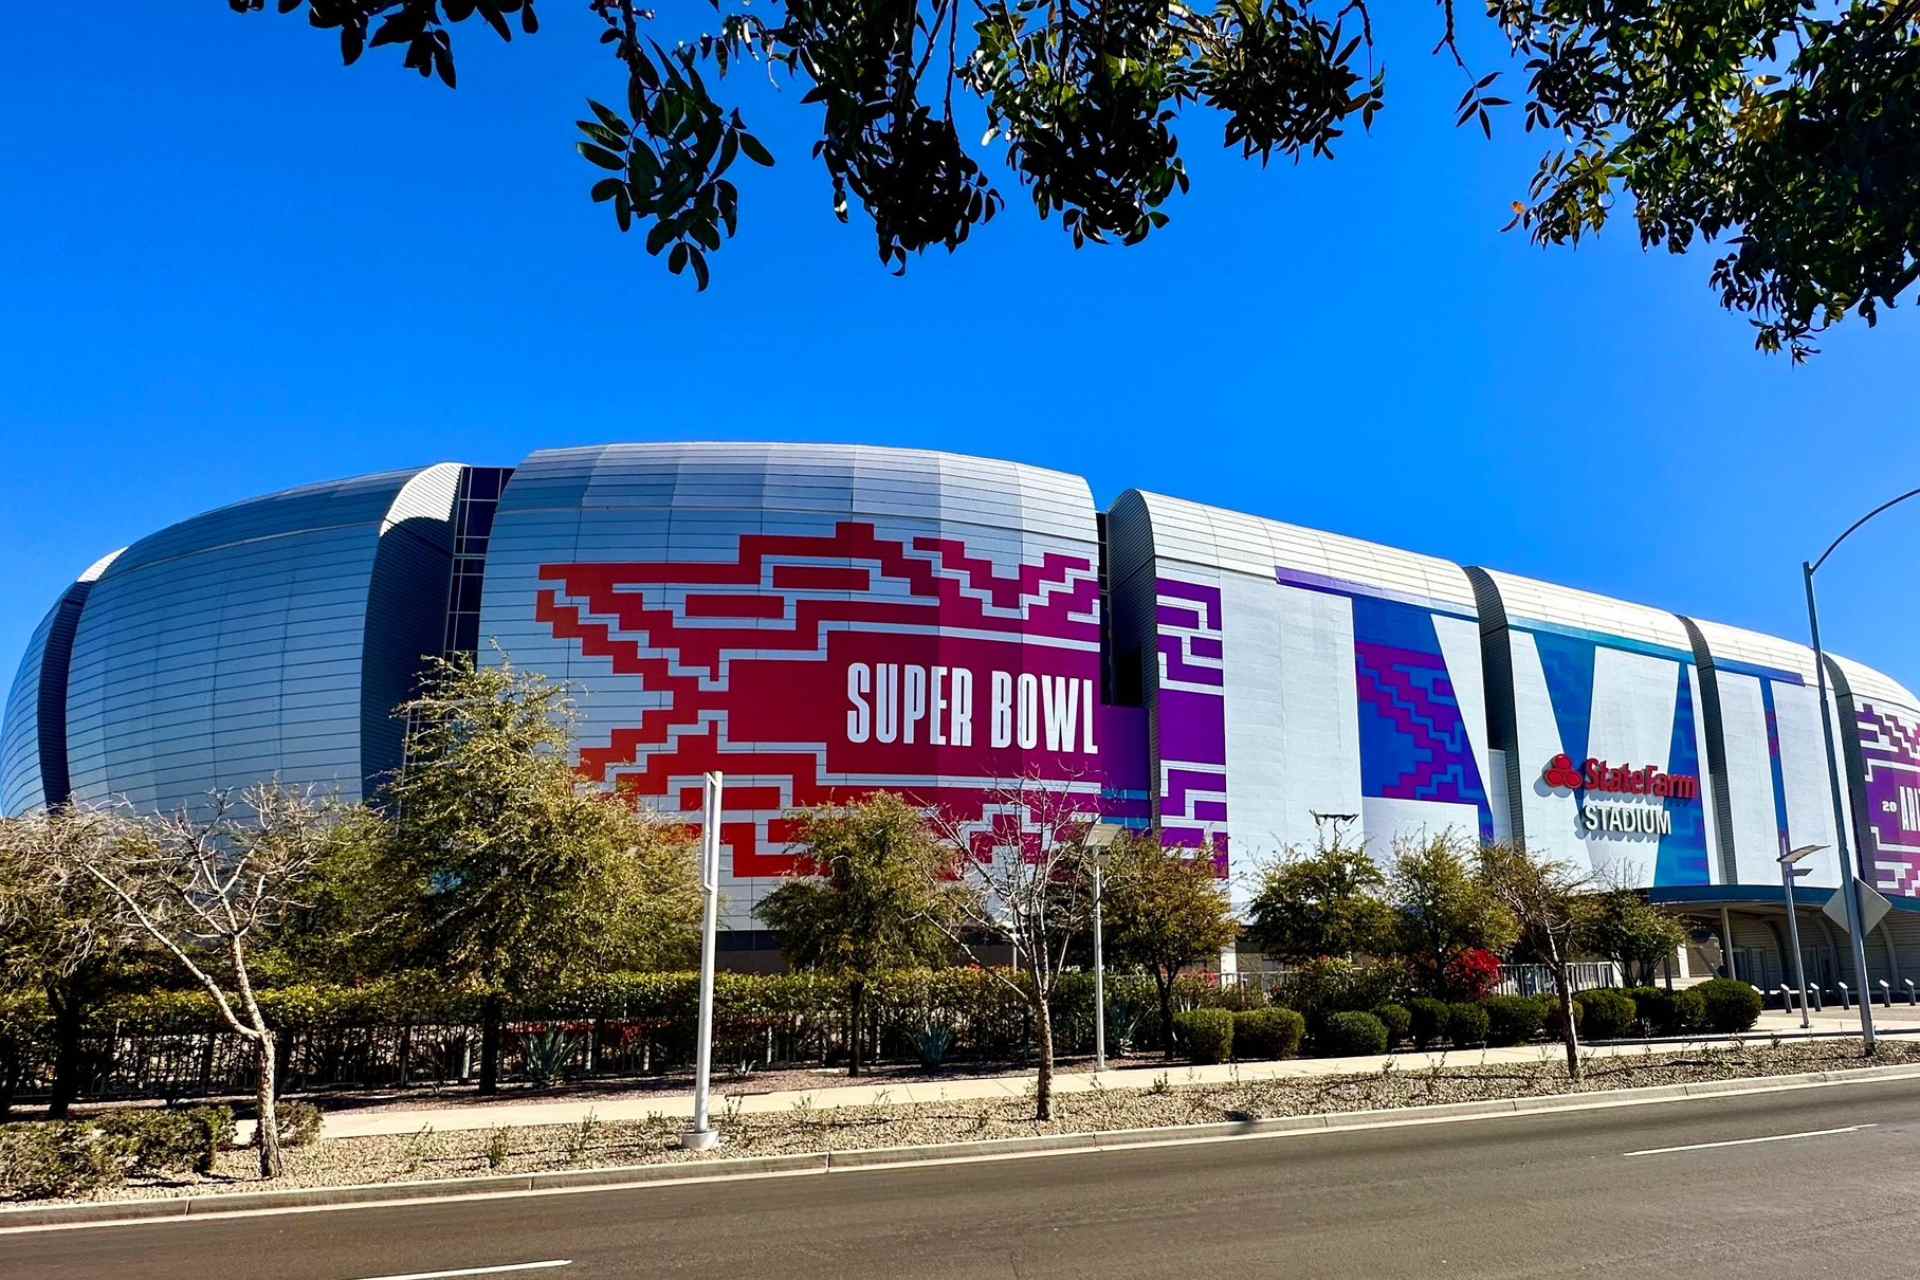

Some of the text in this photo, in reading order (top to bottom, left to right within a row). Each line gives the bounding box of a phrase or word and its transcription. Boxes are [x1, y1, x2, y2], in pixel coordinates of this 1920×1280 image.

[847, 662, 1099, 754] SUPER BOWL
[1585, 805, 1672, 835] STADIUM
